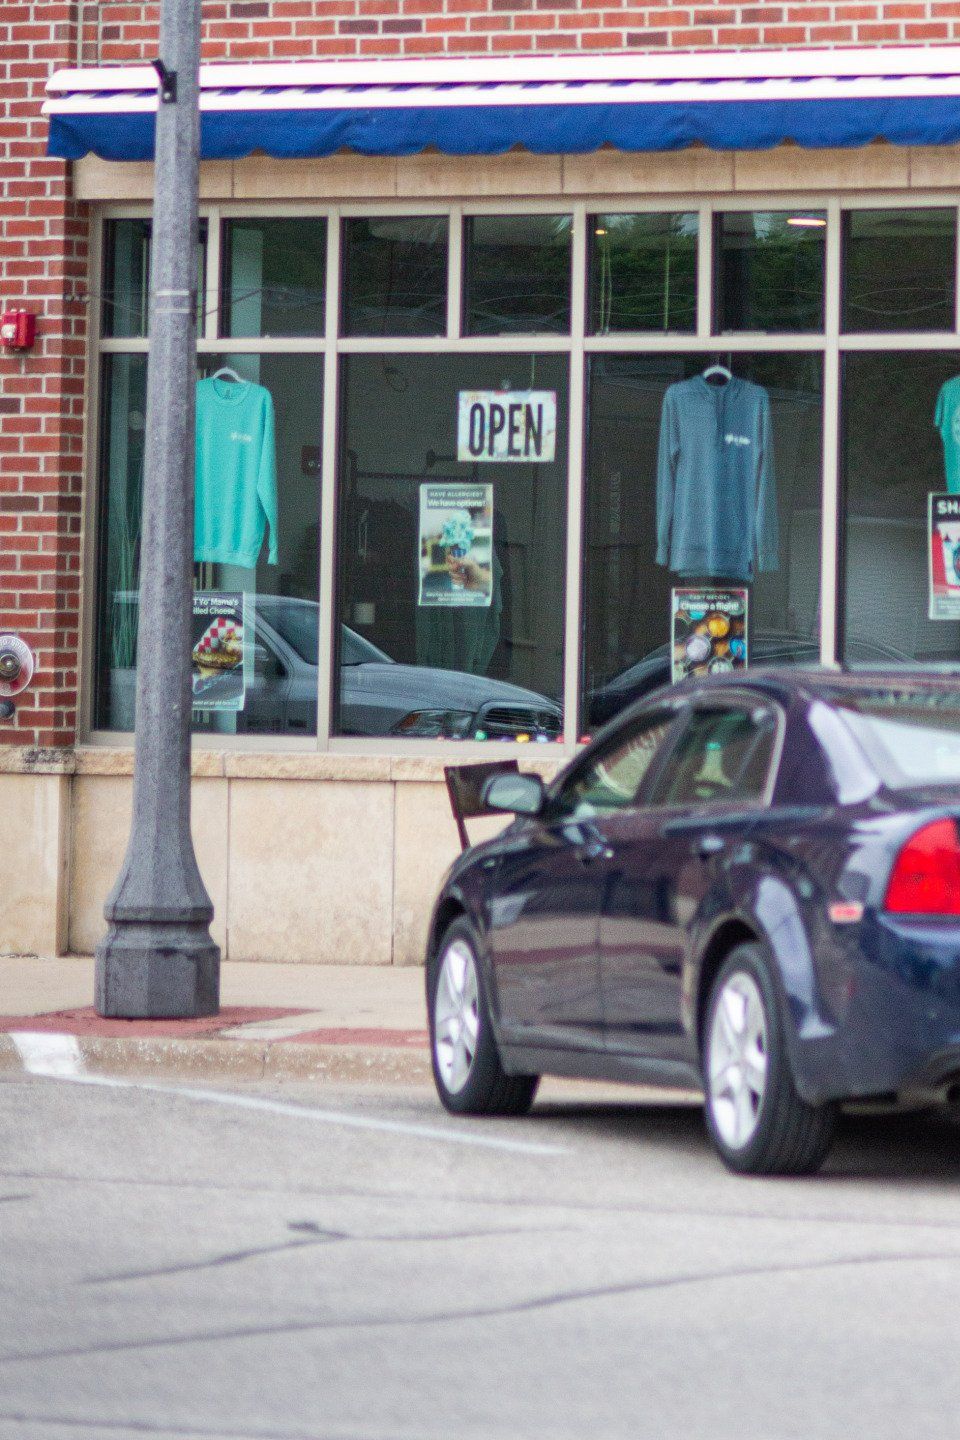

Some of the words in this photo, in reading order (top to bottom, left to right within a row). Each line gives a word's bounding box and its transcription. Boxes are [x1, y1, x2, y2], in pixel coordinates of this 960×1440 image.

[468, 402, 543, 457] OPEN
[193, 607, 208, 615] illed
[209, 607, 236, 615] Cheese
